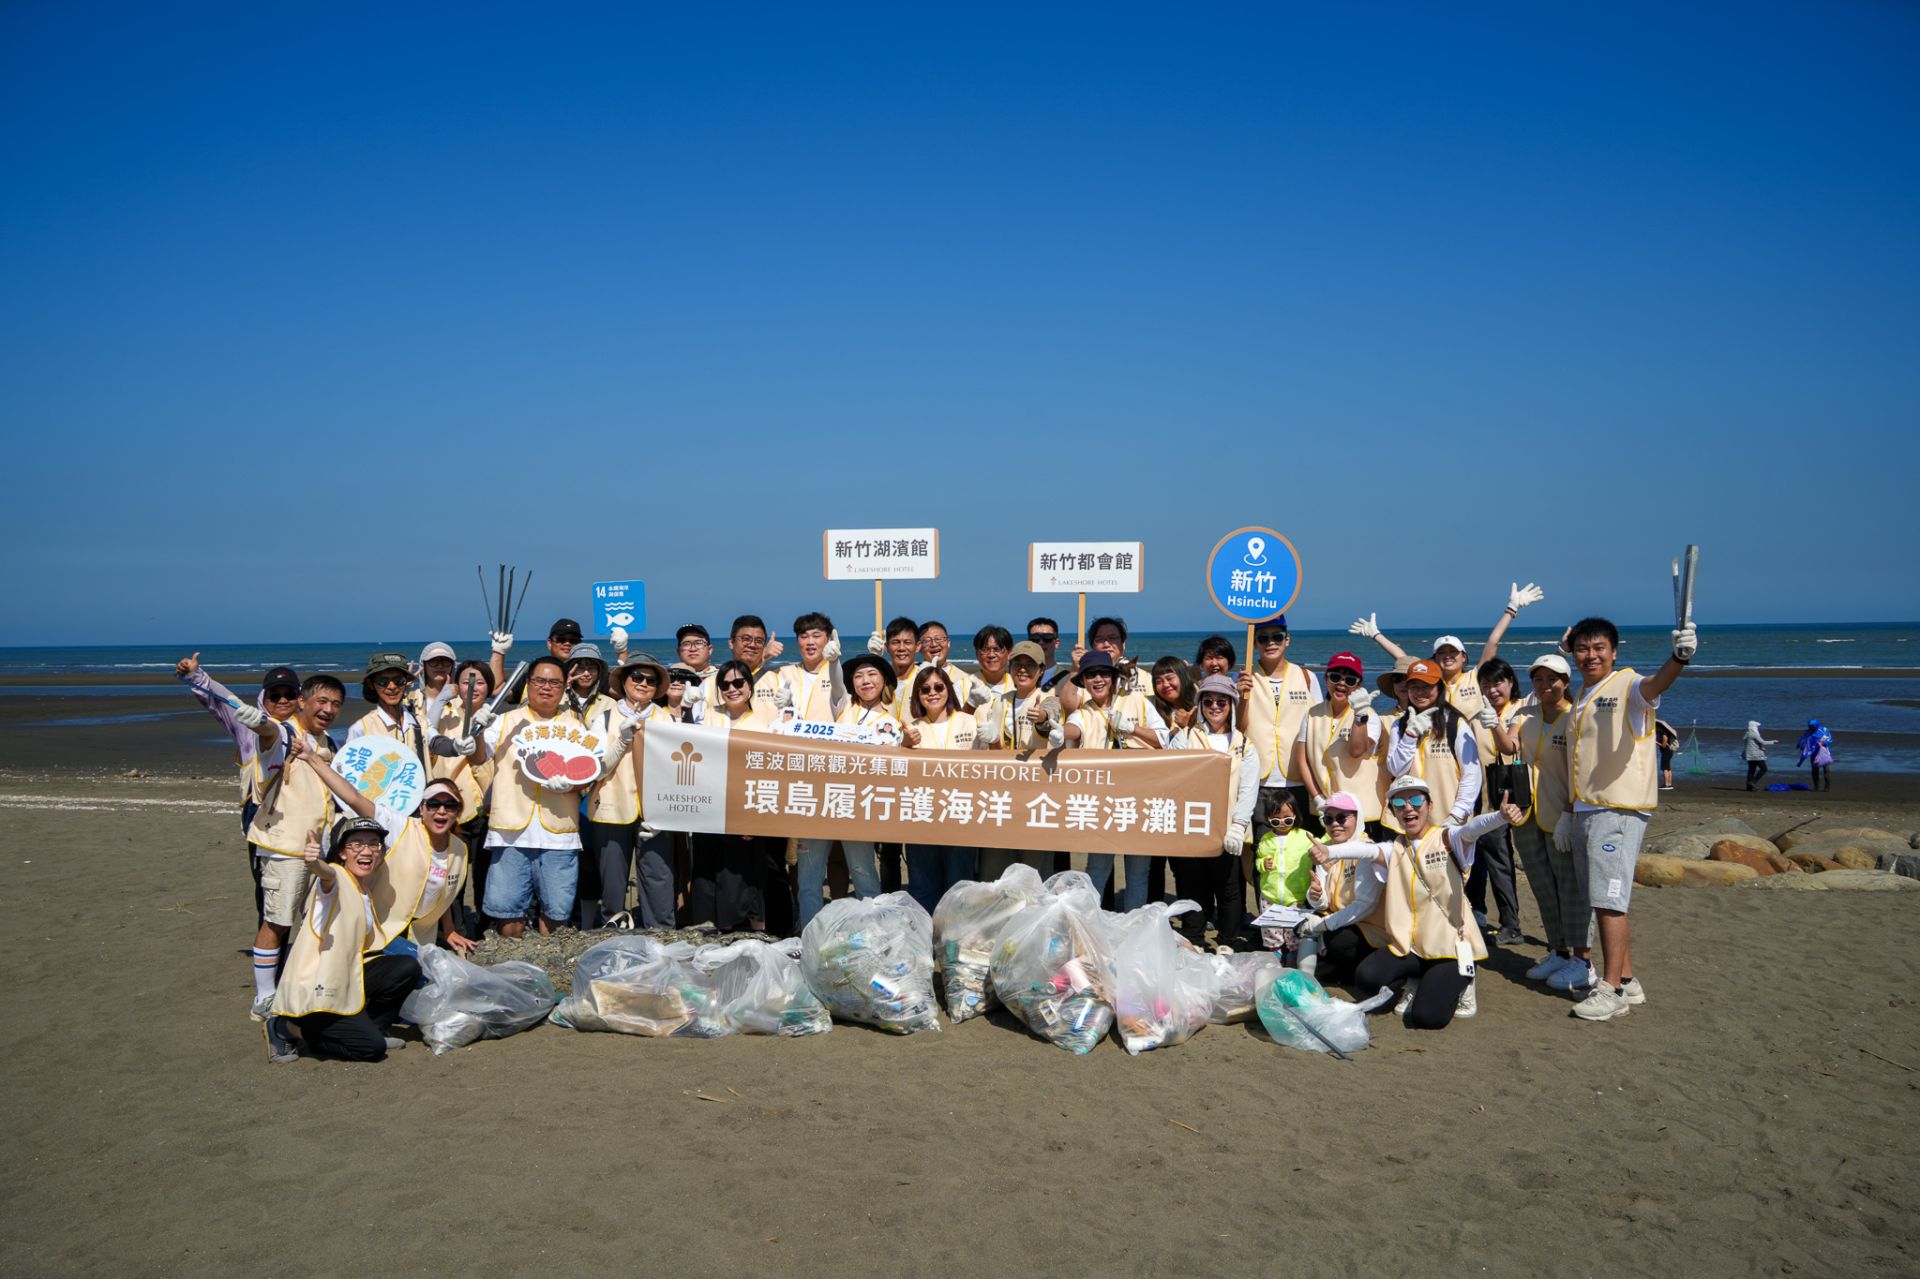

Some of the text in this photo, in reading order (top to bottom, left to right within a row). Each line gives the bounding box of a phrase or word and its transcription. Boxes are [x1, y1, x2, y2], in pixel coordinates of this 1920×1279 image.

[835, 539, 929, 558] 新竹湖濱館
[854, 565, 914, 574] LAKESHORE HOTEL
[1040, 552, 1134, 571] 新竹都會館
[1230, 569, 1277, 594] 新竹
[595, 585, 606, 598] 14
[1227, 595, 1277, 609] Hsinchu
[804, 723, 835, 736] 2025
[745, 751, 908, 777] 煙波國際觀光集團
[922, 761, 1116, 786] LAKESHORE HOTEL
[657, 793, 713, 805] LAKESHORE
[669, 803, 701, 814] HOTEL
[743, 780, 1212, 836] 環島履行護海洋 企業淨灘日
